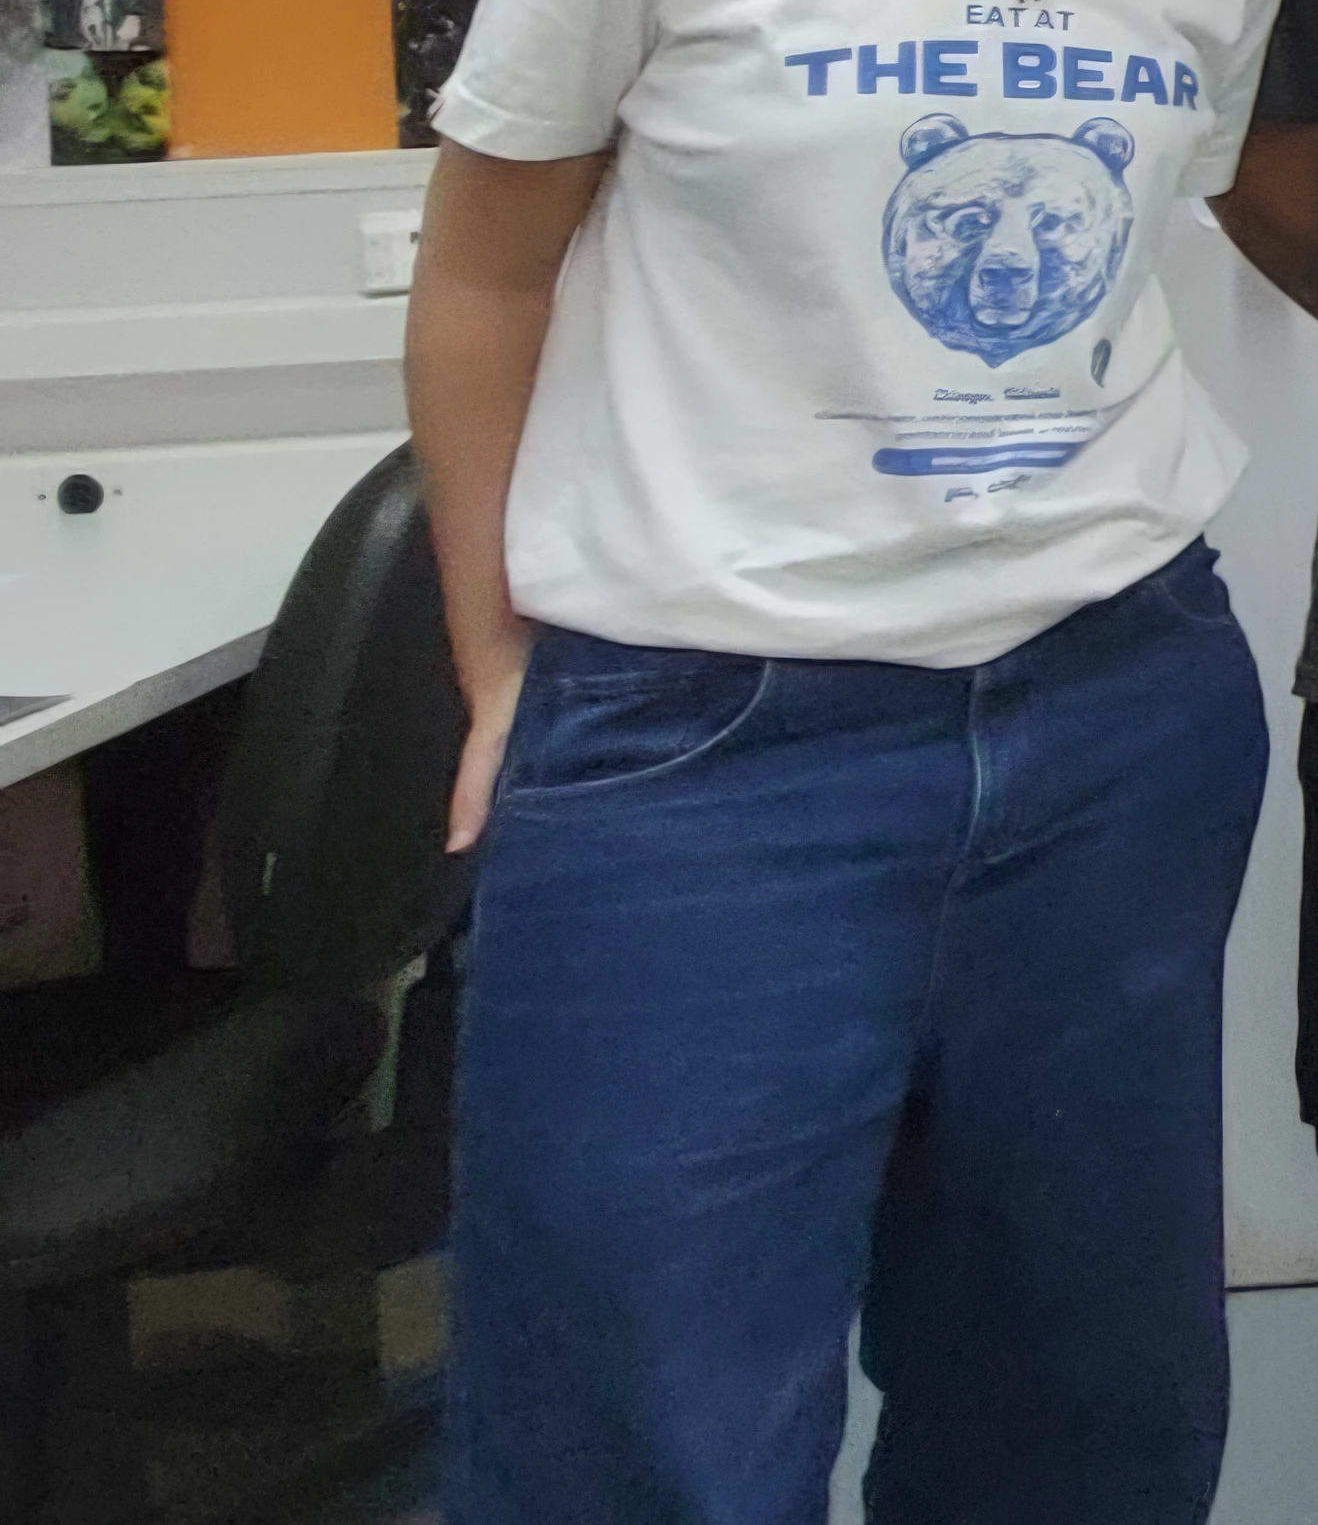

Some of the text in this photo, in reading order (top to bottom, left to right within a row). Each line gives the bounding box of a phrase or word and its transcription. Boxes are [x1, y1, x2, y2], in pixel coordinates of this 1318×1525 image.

[966, 4, 1076, 32] EAT AT
[784, 40, 1200, 112] THE BEAR
